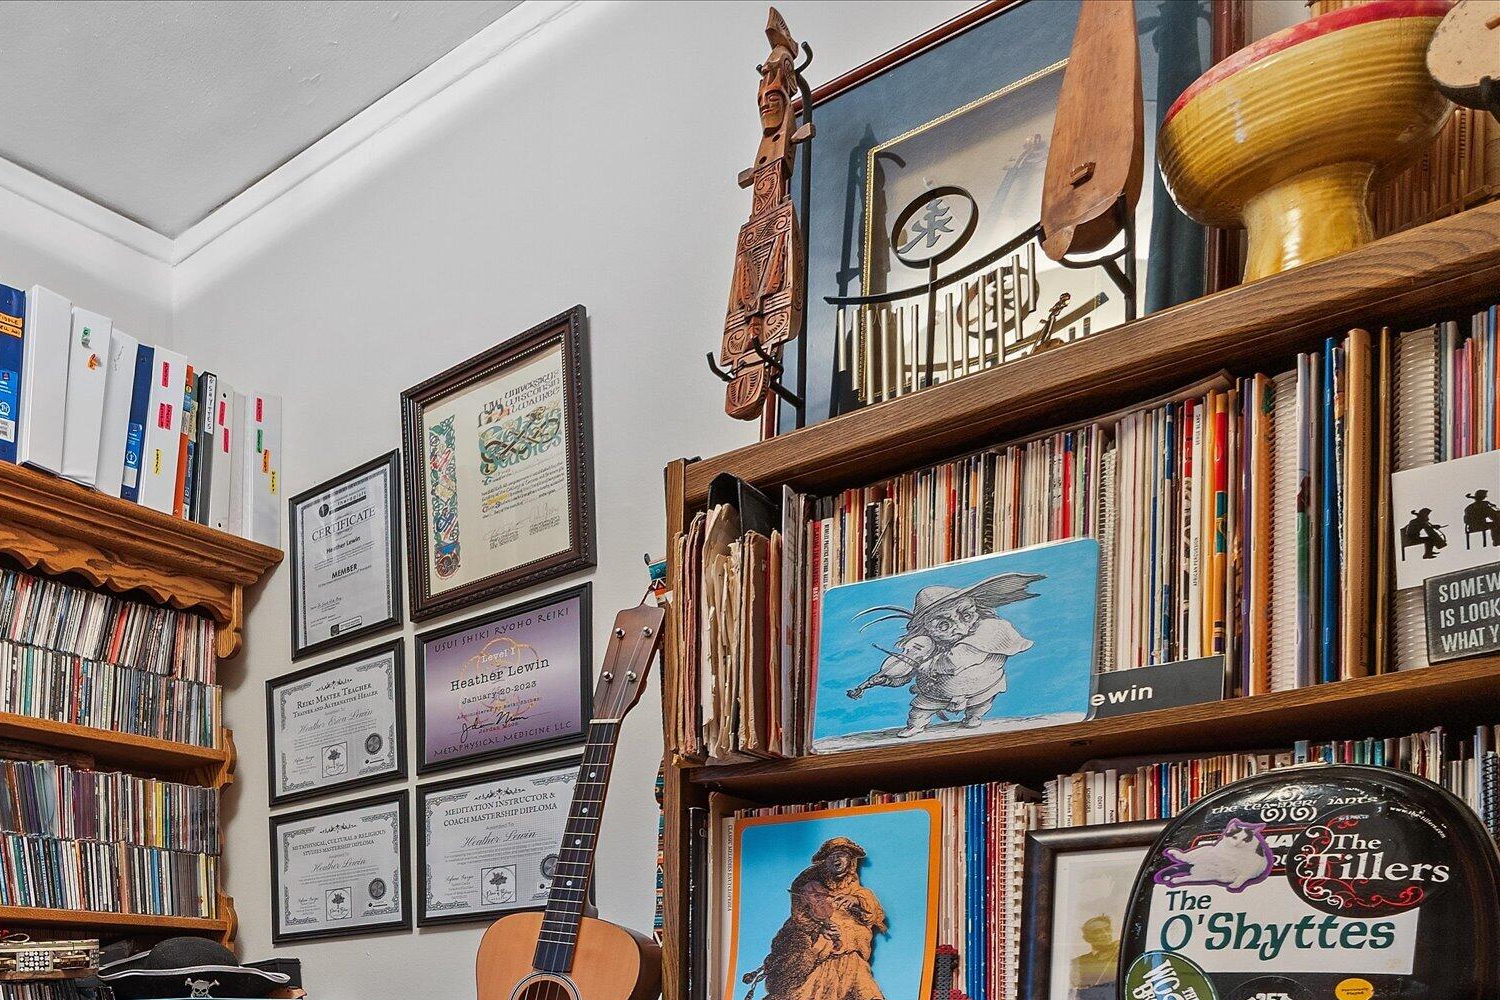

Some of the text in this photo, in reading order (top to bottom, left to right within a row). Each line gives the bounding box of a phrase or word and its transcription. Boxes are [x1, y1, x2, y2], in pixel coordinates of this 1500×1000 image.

[312, 506, 376, 542] CERTIFICATE
[331, 563, 358, 579] MEMBER
[434, 607, 569, 653] USUI SHIKI RYOHO REIKI
[1440, 608, 1455, 628] IS
[1441, 626, 1486, 653] WHAT
[450, 658, 550, 692] Heather Lewin
[342, 683, 372, 695] TEACHER
[433, 721, 571, 757] METAPHYSICAL MEDICINE LLC
[444, 803, 558, 827] COACH MASTERSHIP DIPLOMA
[445, 802, 495, 816] MEDITATION
[495, 793, 548, 808] INSTRUCTOR
[1332, 834, 1381, 850] The
[1306, 852, 1450, 884] Tillers
[1165, 890, 1211, 910] The
[1160, 912, 1396, 962] O'Shyttes
